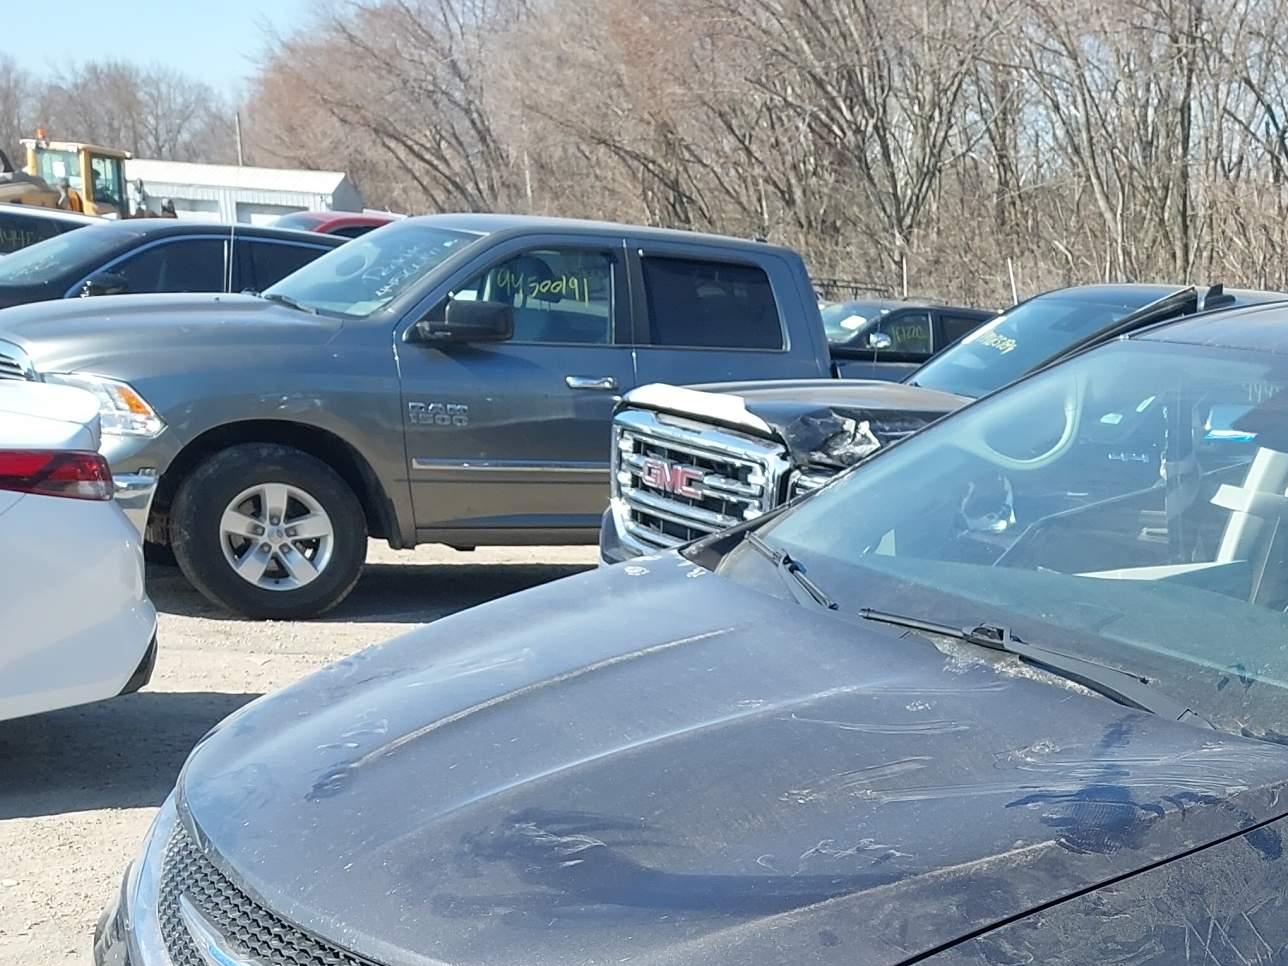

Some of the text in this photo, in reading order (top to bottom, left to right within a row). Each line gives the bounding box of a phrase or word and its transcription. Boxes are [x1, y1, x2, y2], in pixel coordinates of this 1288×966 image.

[408, 402, 469, 414] RAM
[409, 414, 469, 427] 1500
[642, 457, 705, 502] GMC
